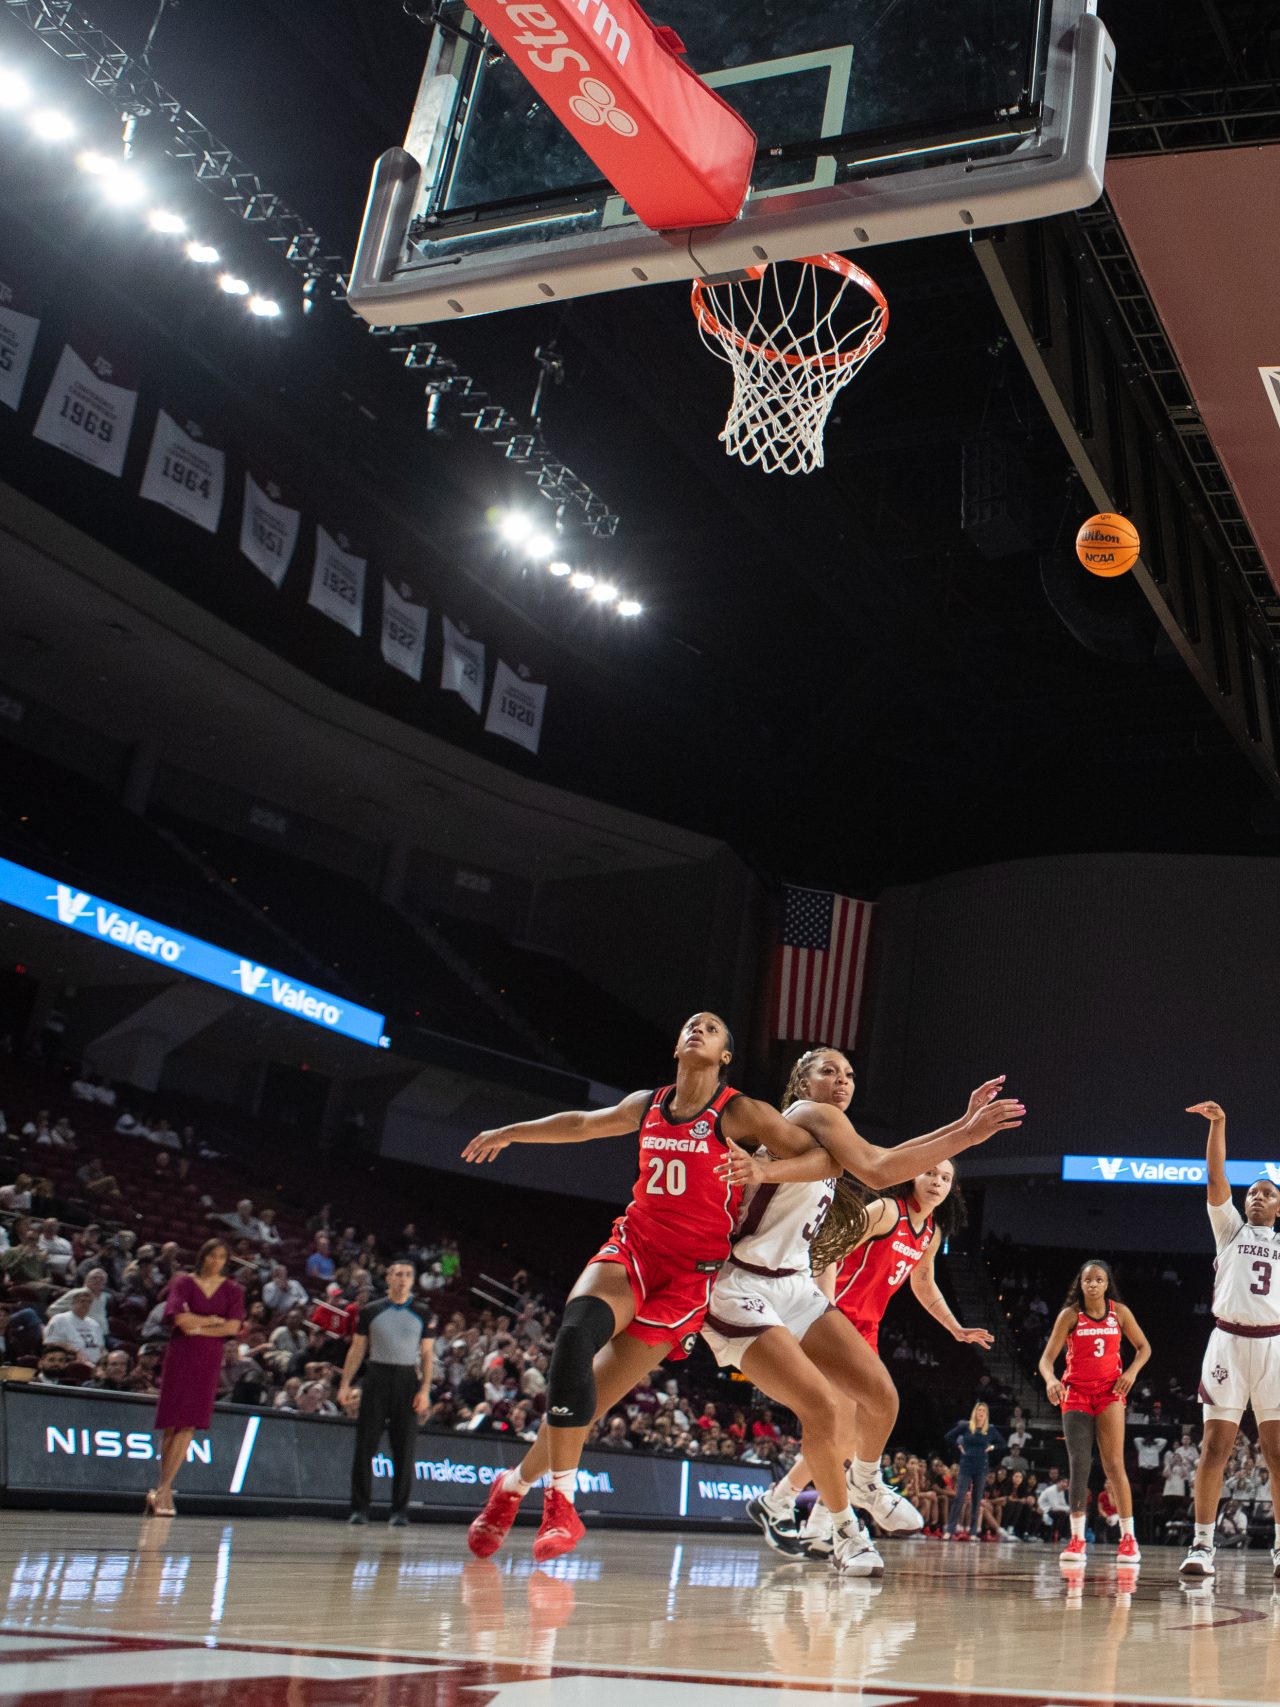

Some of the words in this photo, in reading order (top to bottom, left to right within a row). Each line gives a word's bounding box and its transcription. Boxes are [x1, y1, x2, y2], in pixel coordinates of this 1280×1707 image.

[499, 0, 591, 73] Sta
[59, 395, 114, 442] 1969
[161, 456, 211, 499] 1964
[1085, 552, 1115, 563] NCAA
[501, 696, 535, 728] 1920
[97, 906, 182, 962] Valero
[270, 978, 341, 1025] Valero
[642, 1136, 710, 1154] GEORGIA
[646, 1157, 687, 1196] 20
[1130, 1161, 1203, 1181] Valero
[802, 1194, 832, 1242] 3
[1238, 1244, 1270, 1258] TEXAS
[1250, 1260, 1272, 1296] 3
[1077, 1328, 1119, 1337] GEORGIA
[1093, 1338, 1105, 1358] 3
[46, 1425, 213, 1465] NISSN
[414, 1457, 478, 1484] makes
[698, 1480, 765, 1502] NISSAN
